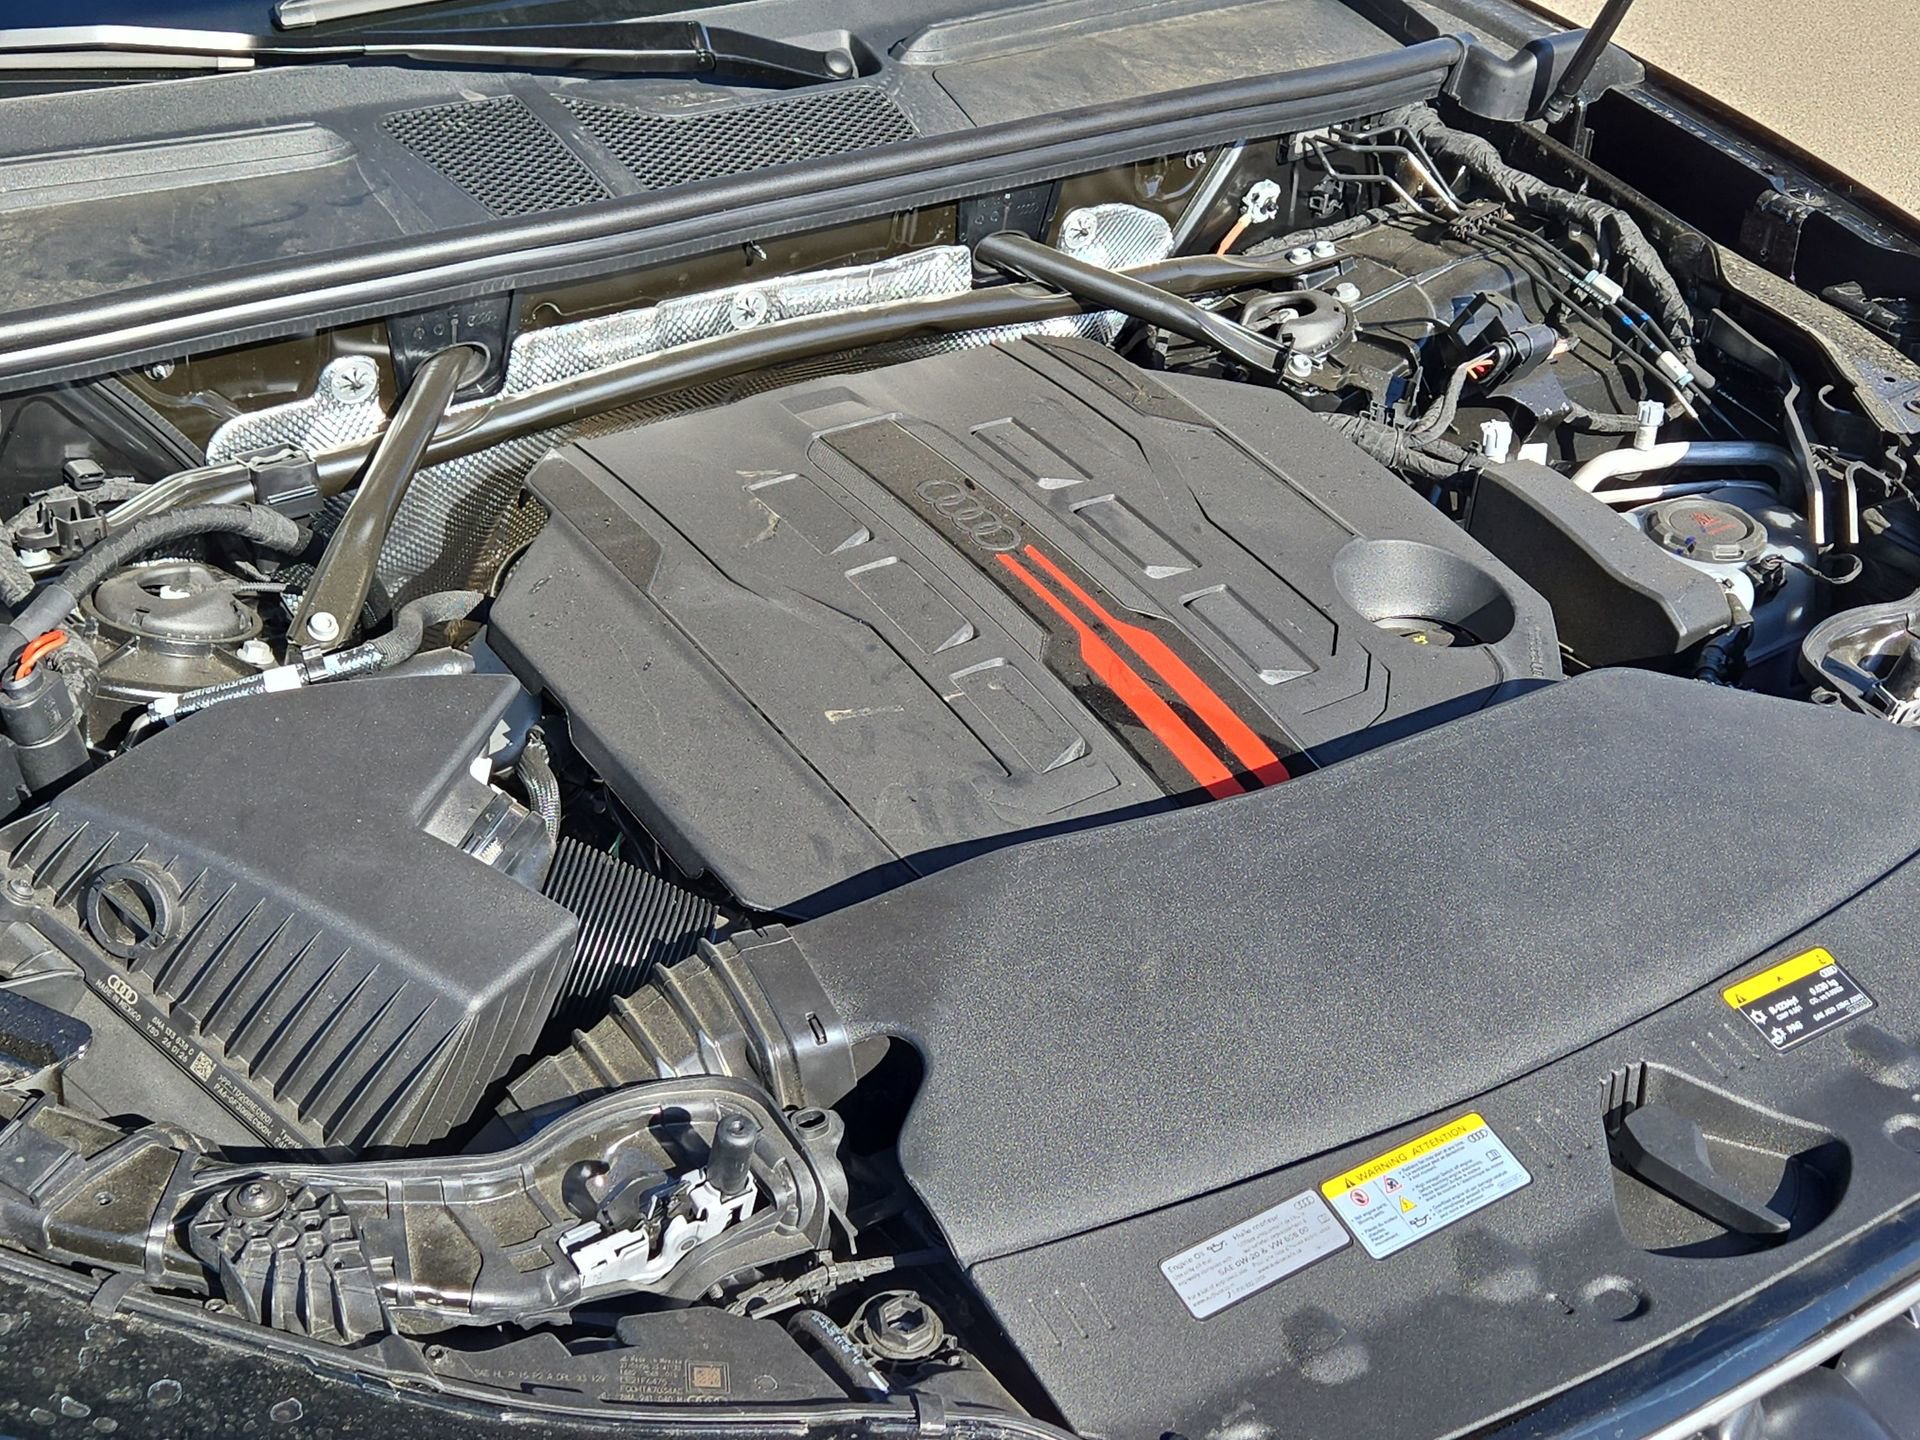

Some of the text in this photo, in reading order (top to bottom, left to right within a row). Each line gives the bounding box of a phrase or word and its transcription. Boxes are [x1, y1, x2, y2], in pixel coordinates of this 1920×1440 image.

[95, 979, 141, 1021] MADE IN MEXICO
[1356, 1126, 1467, 1181] WARNING ATTENTION
[1167, 1258, 1193, 1273] Engine
